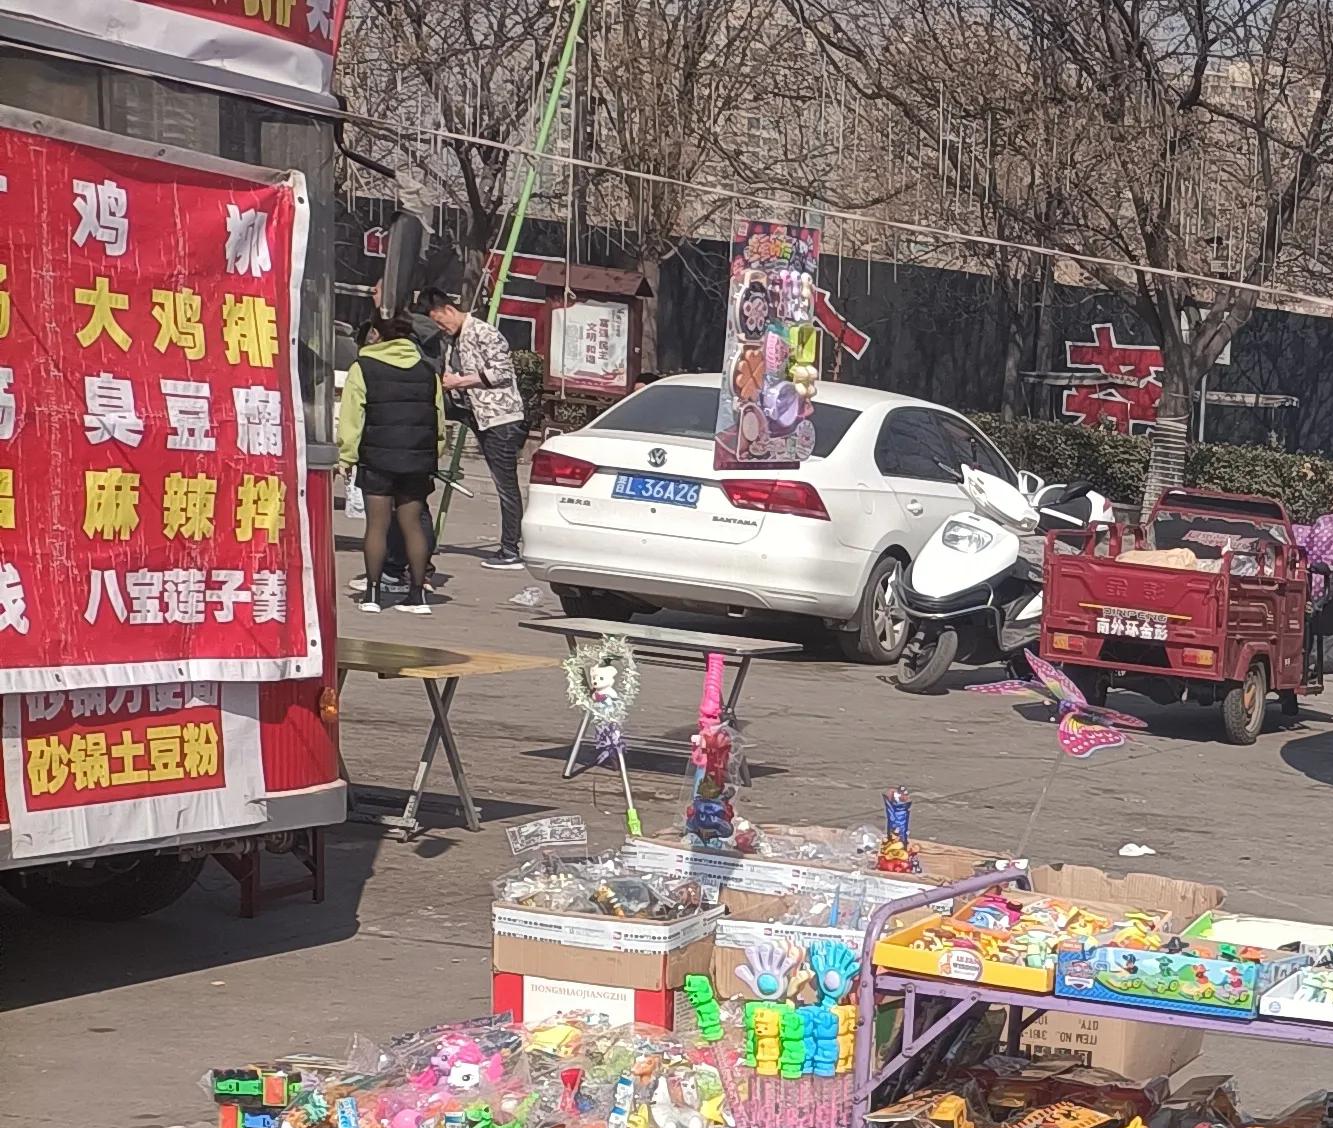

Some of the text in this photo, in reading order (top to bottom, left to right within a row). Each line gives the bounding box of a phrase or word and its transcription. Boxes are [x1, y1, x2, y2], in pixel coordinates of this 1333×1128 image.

[75, 277, 279, 368] 大鸡排
[84, 373, 282, 456] 臭豆腐
[83, 468, 287, 543] 麻辣拌
[84, 568, 286, 625] 八宝莲子羹
[1097, 616, 1168, 640] 南外环金彭
[27, 722, 218, 796] 砂锅土豆粉
